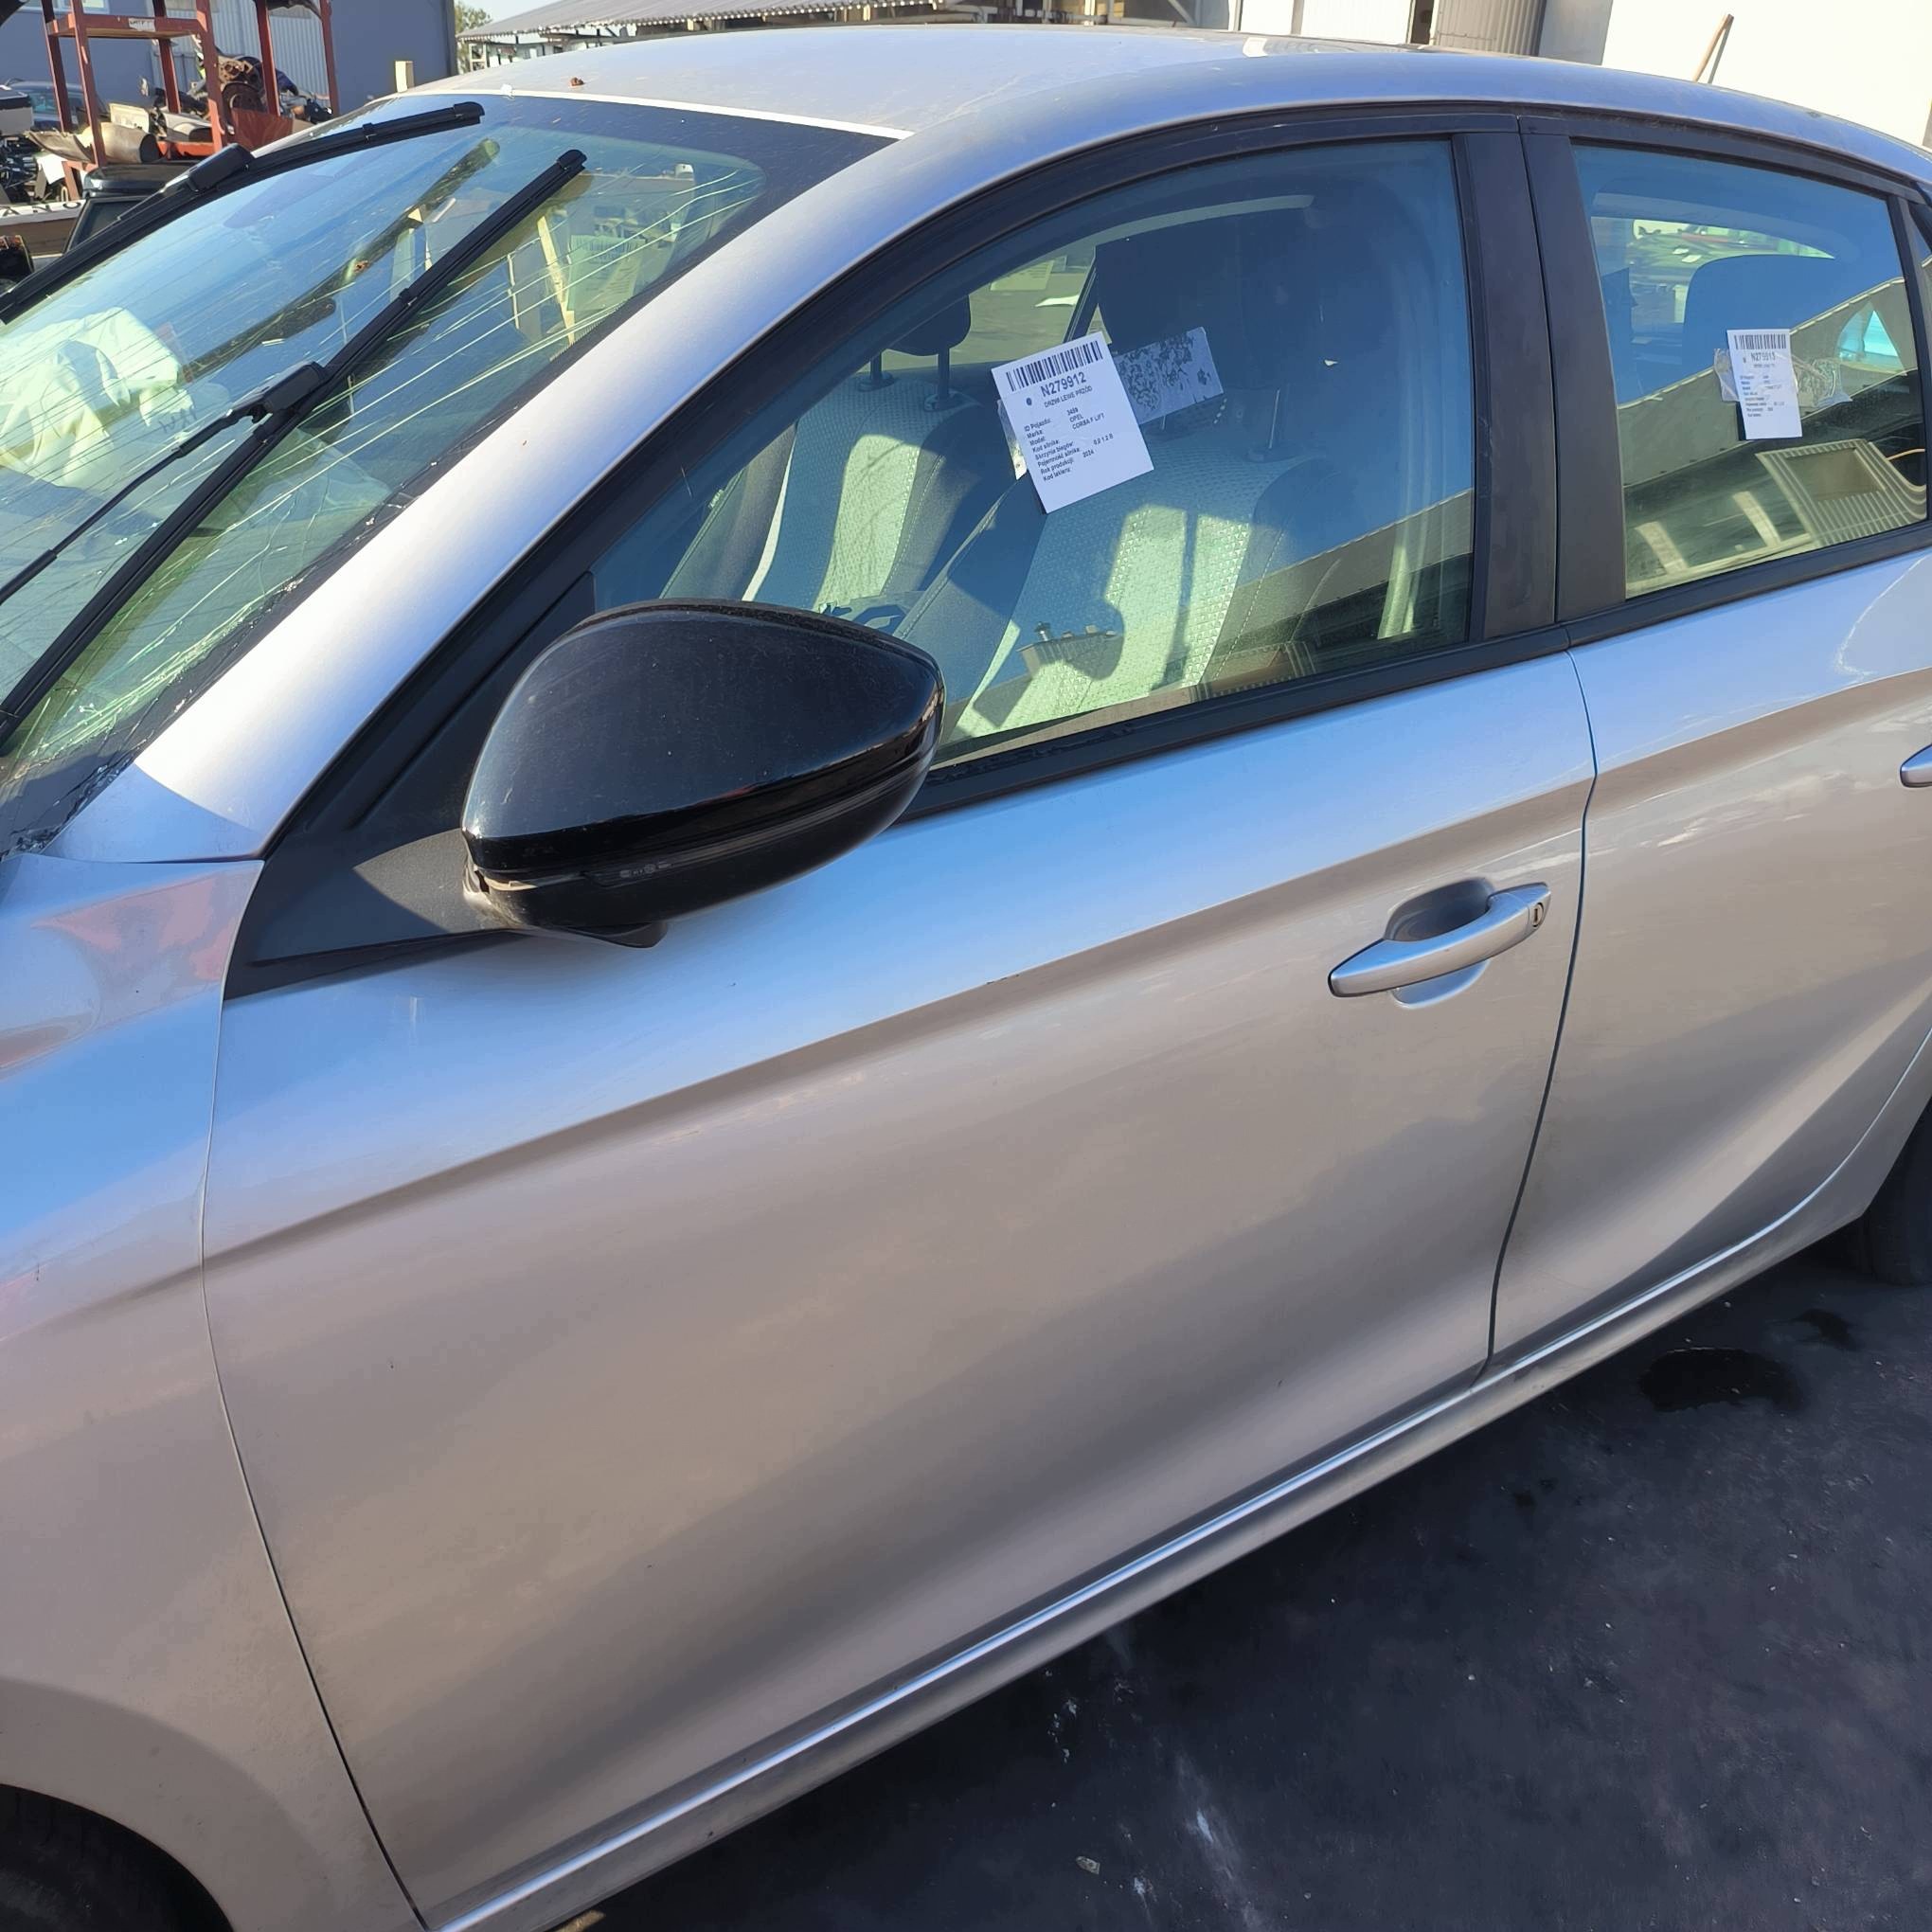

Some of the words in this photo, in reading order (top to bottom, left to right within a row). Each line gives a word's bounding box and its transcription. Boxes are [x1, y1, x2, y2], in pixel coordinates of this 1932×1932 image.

[1040, 371, 1086, 397] N279912
[1069, 413, 1083, 422] OPEL
[1040, 466, 1050, 474] Rok
